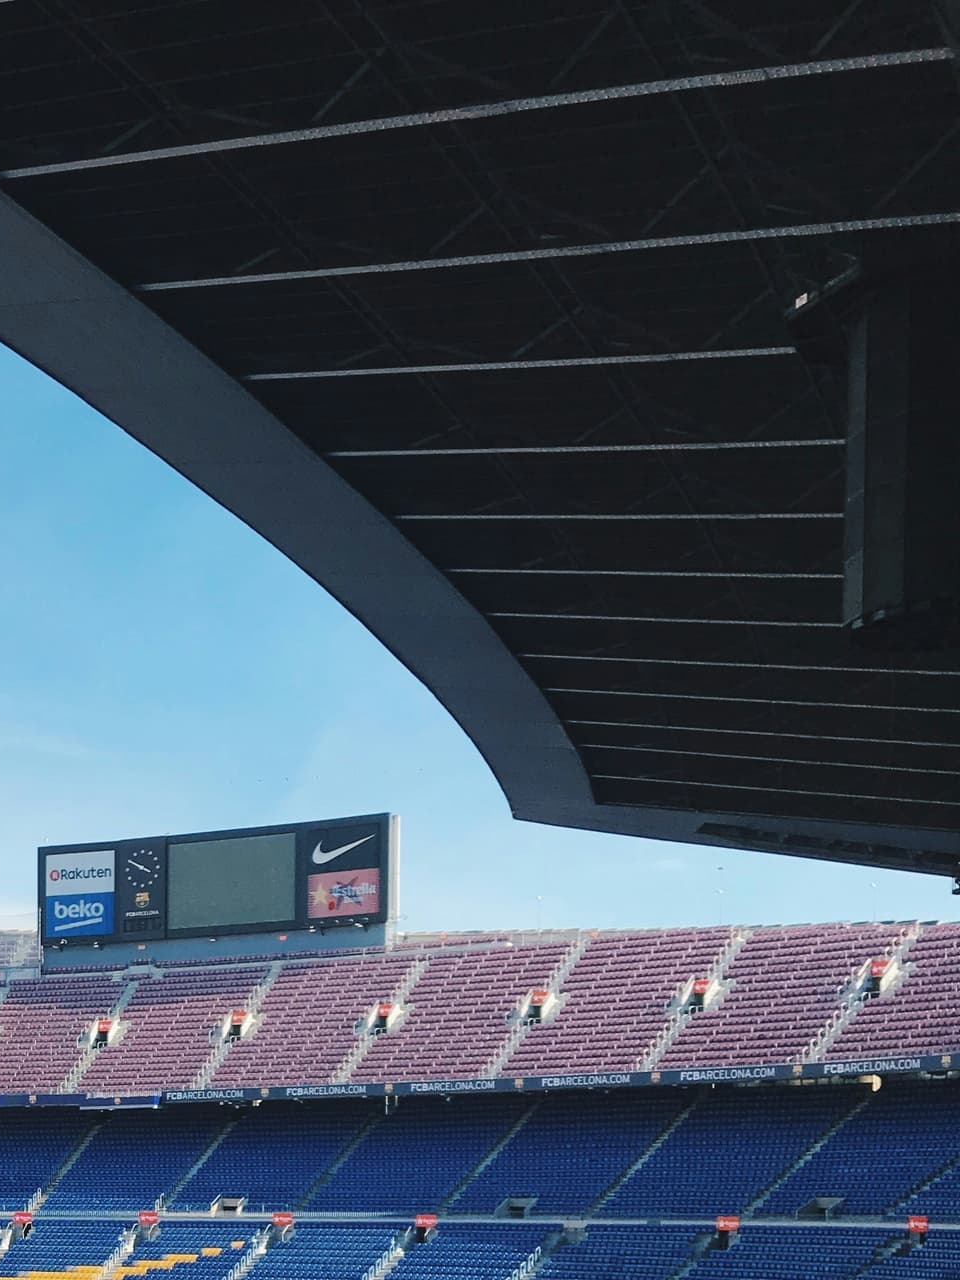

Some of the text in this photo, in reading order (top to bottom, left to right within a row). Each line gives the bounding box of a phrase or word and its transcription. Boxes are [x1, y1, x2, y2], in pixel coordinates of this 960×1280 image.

[60, 868, 112, 880] Rakuten
[54, 899, 104, 919] beko
[824, 1059, 920, 1075] FCBARCELONA.COM
[680, 1068, 775, 1081] FCBARCELONA.COM
[411, 1081, 495, 1092] FCBARCELONA.COM
[541, 1075, 630, 1087] FCBARCELONA.COM
[166, 1090, 243, 1100] FCBARCELONA.COM
[286, 1086, 366, 1096] FCBARCELONA.COM
